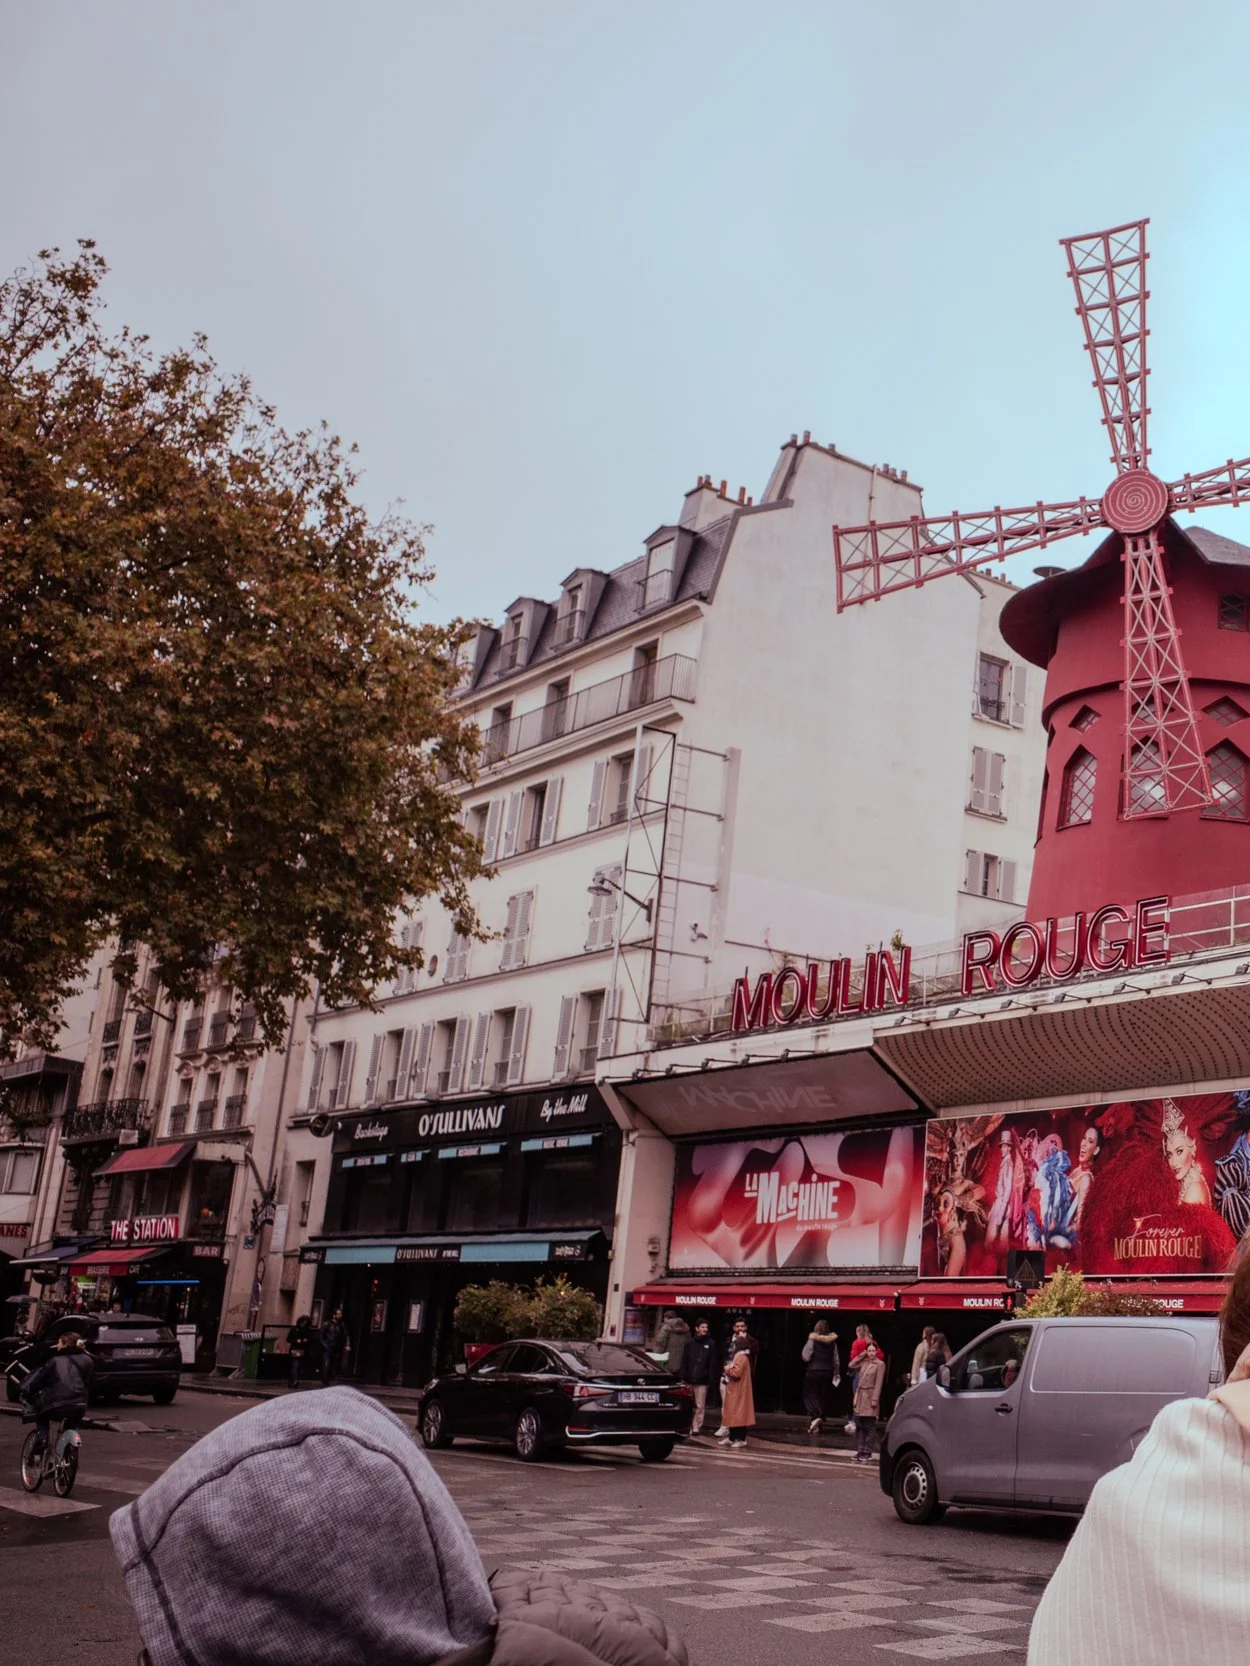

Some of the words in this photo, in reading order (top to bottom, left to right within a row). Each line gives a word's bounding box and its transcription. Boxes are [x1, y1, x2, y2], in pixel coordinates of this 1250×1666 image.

[731, 944, 911, 1031] MOULIN
[961, 896, 1172, 994] ROUGE
[540, 1098, 553, 1122] By
[567, 1093, 588, 1114] Mill
[354, 1121, 388, 1142] Backstage
[418, 1104, 506, 1137] O'SULLIVANS
[744, 1173, 758, 1192] LA
[111, 1219, 128, 1241] THE
[133, 1216, 176, 1240] STATION
[1125, 1213, 1185, 1239] Forever
[194, 1246, 219, 1257] BAR
[1113, 1237, 1158, 1260] MOULIN
[1160, 1235, 1202, 1259] ROUGE
[675, 1295, 696, 1304] MOULIN
[697, 1296, 717, 1305] ROUGE
[790, 1298, 815, 1307] MOULIN
[815, 1298, 839, 1308] ROUGE
[963, 1298, 992, 1307] MOULIN
